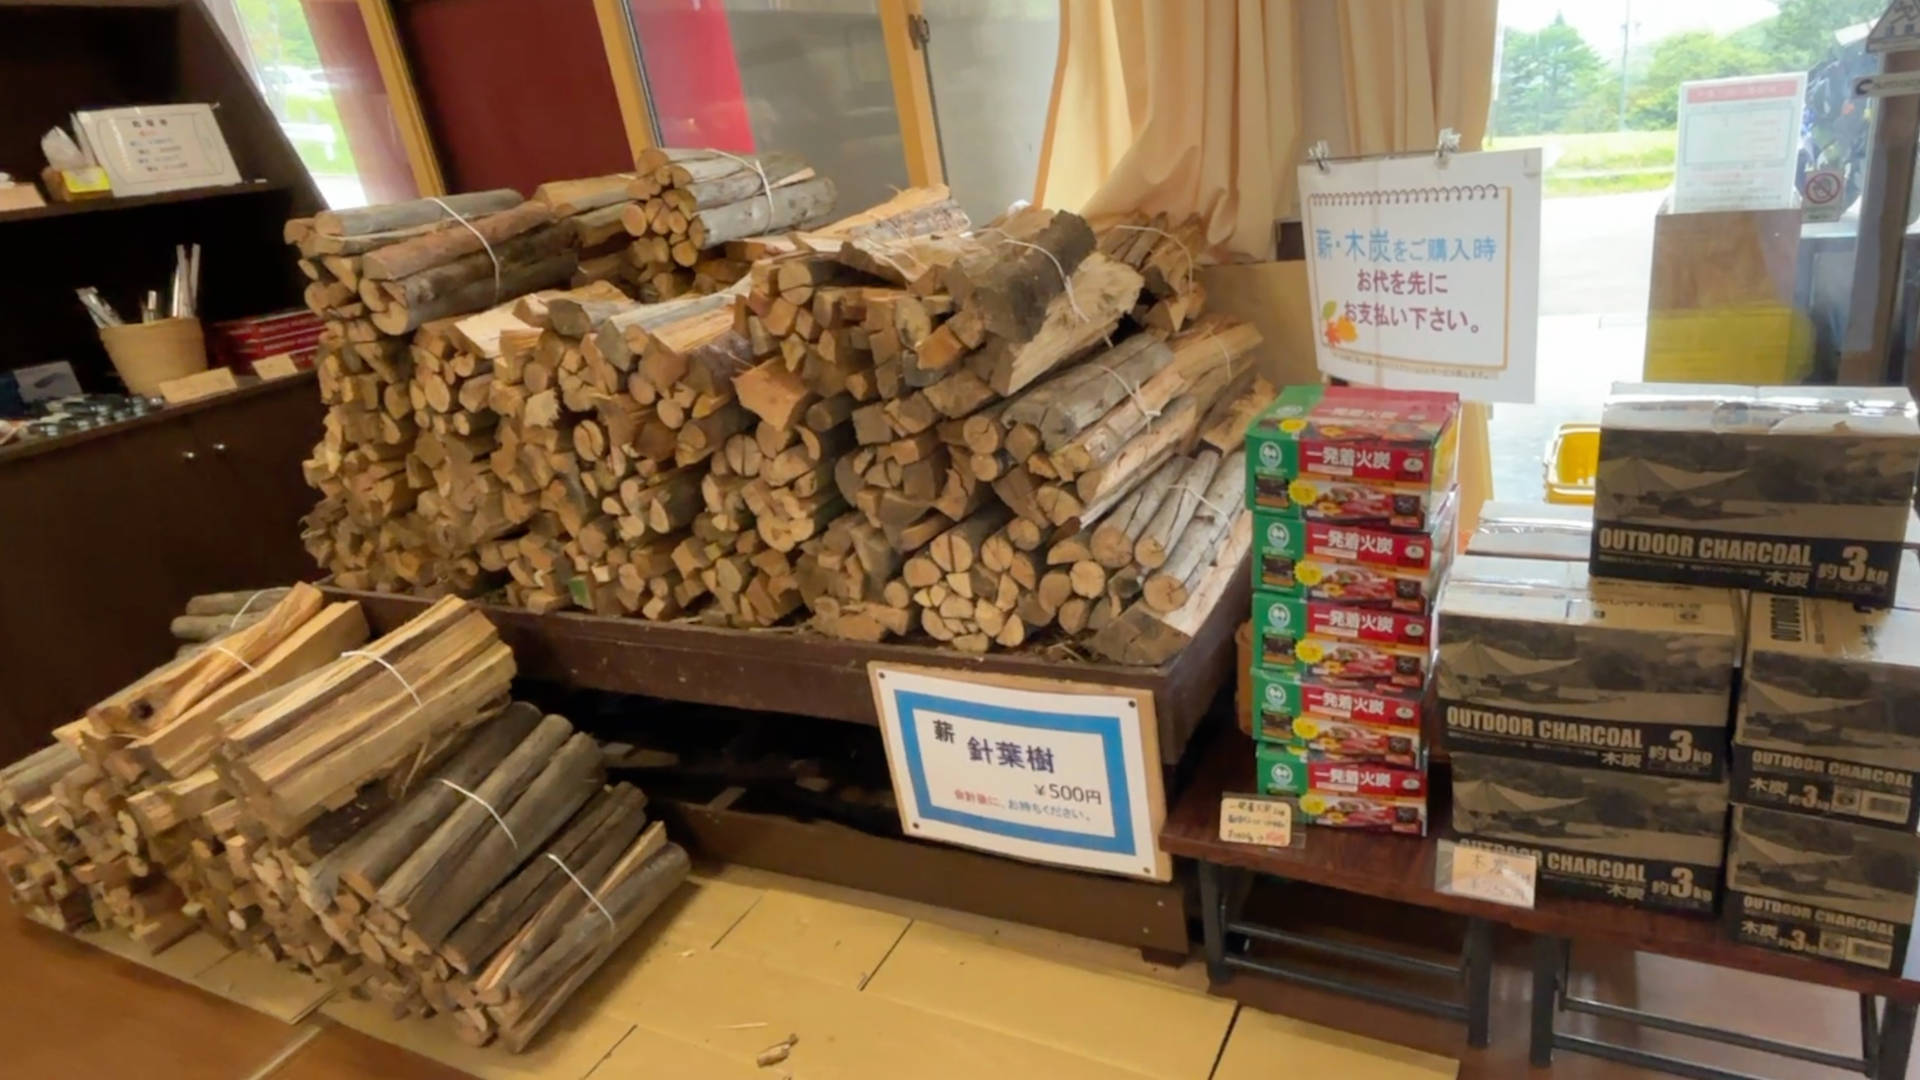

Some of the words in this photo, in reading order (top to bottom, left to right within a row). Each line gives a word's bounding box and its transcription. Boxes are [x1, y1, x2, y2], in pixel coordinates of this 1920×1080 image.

[1357, 268, 1448, 295] お代を先に
[1344, 300, 1480, 334] お支払い下さい。
[1306, 446, 1390, 470] 一発着火炭
[1312, 530, 1393, 555] 一発着火炭
[1599, 527, 1694, 558] OUTDOOR
[1699, 537, 1812, 567] CHARCOAL
[1764, 569, 1809, 590] 木炭
[1313, 610, 1394, 633] 一発着火炭
[1447, 706, 1534, 736] OUTDOOR
[1538, 720, 1643, 749] CHARCOAL
[966, 736, 1055, 774] 針葉樹
[1752, 750, 1825, 772] OUTDOOR
[1828, 761, 1913, 788] CHARCOAL
[1547, 852, 1647, 883] CHARCOAL
[1744, 896, 1812, 919] OUTDOOR
[1814, 909, 1895, 937] CHARCOAL
